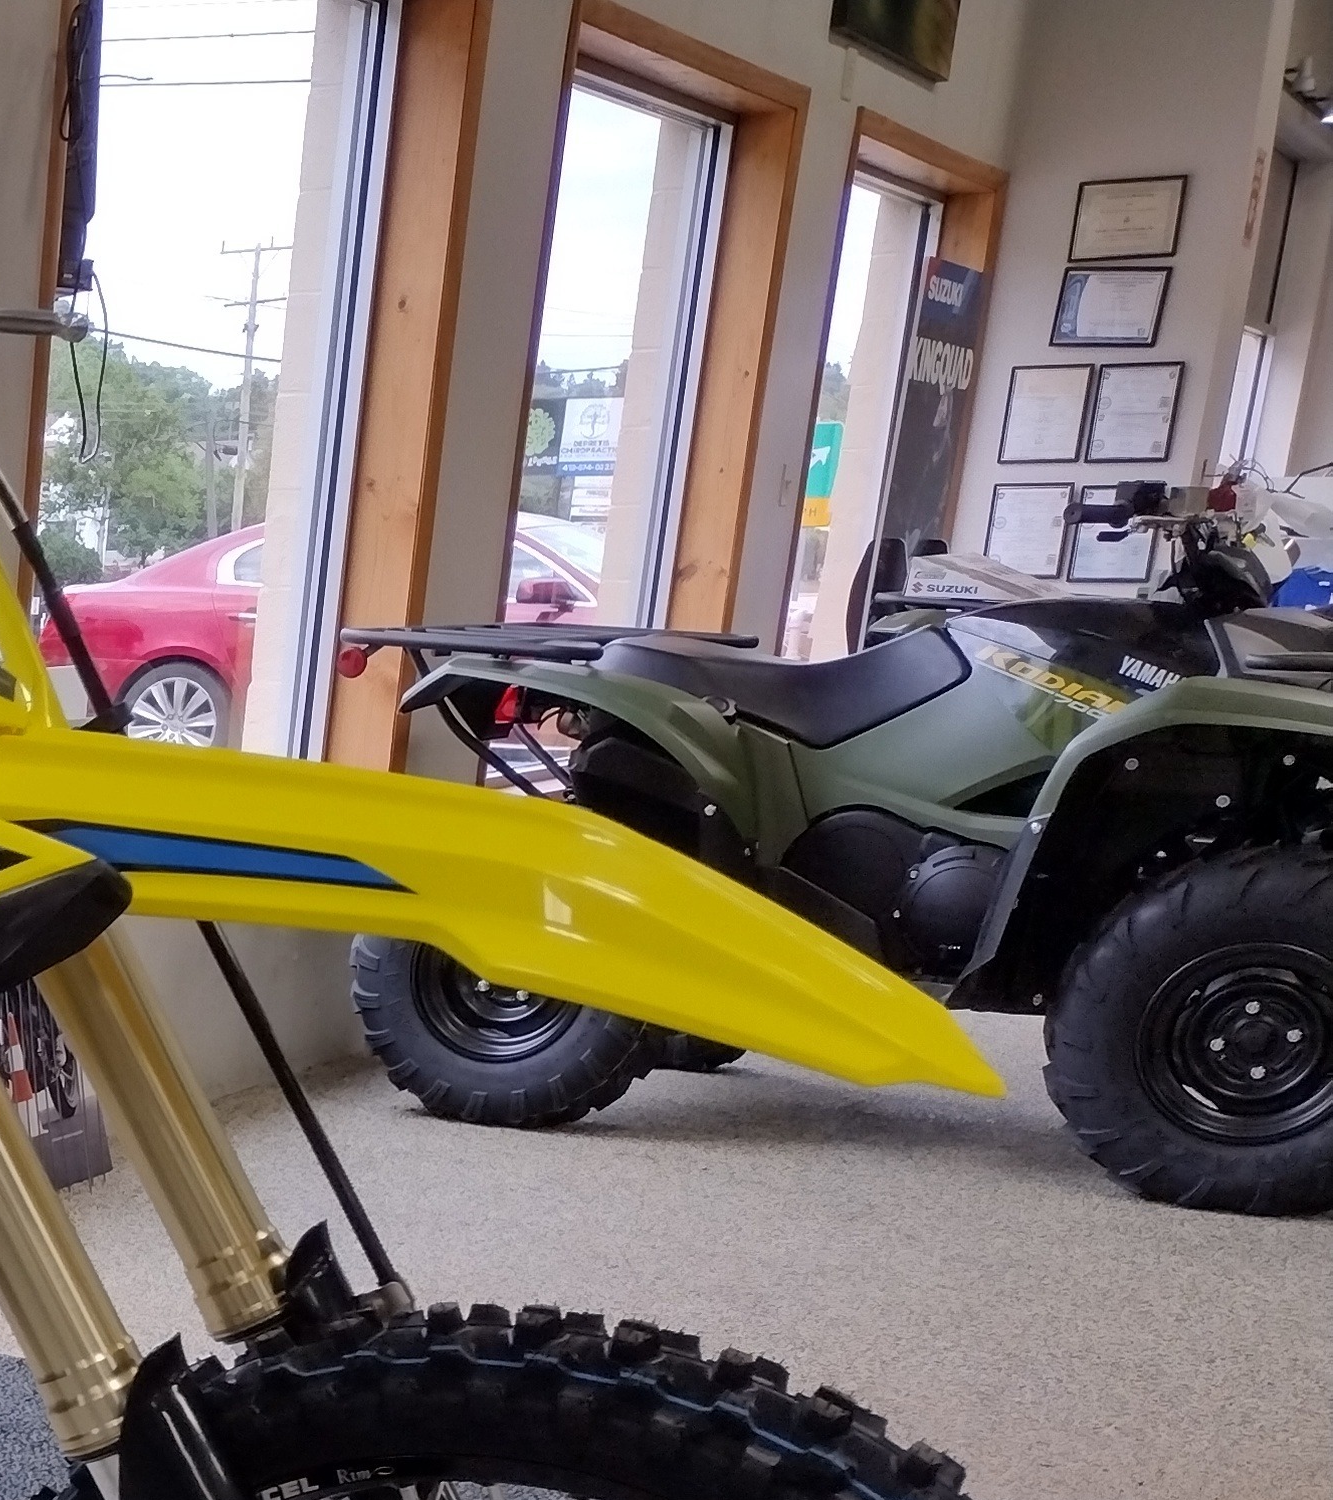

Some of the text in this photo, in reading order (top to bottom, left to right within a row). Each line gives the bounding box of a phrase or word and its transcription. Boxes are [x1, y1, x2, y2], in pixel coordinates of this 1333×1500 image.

[927, 275, 965, 307] SUZUKI
[913, 337, 974, 396] KINGQUAD
[926, 583, 979, 595] SUZUKI
[1117, 654, 1187, 689] YAMAH
[336, 1467, 382, 1484] Rim
